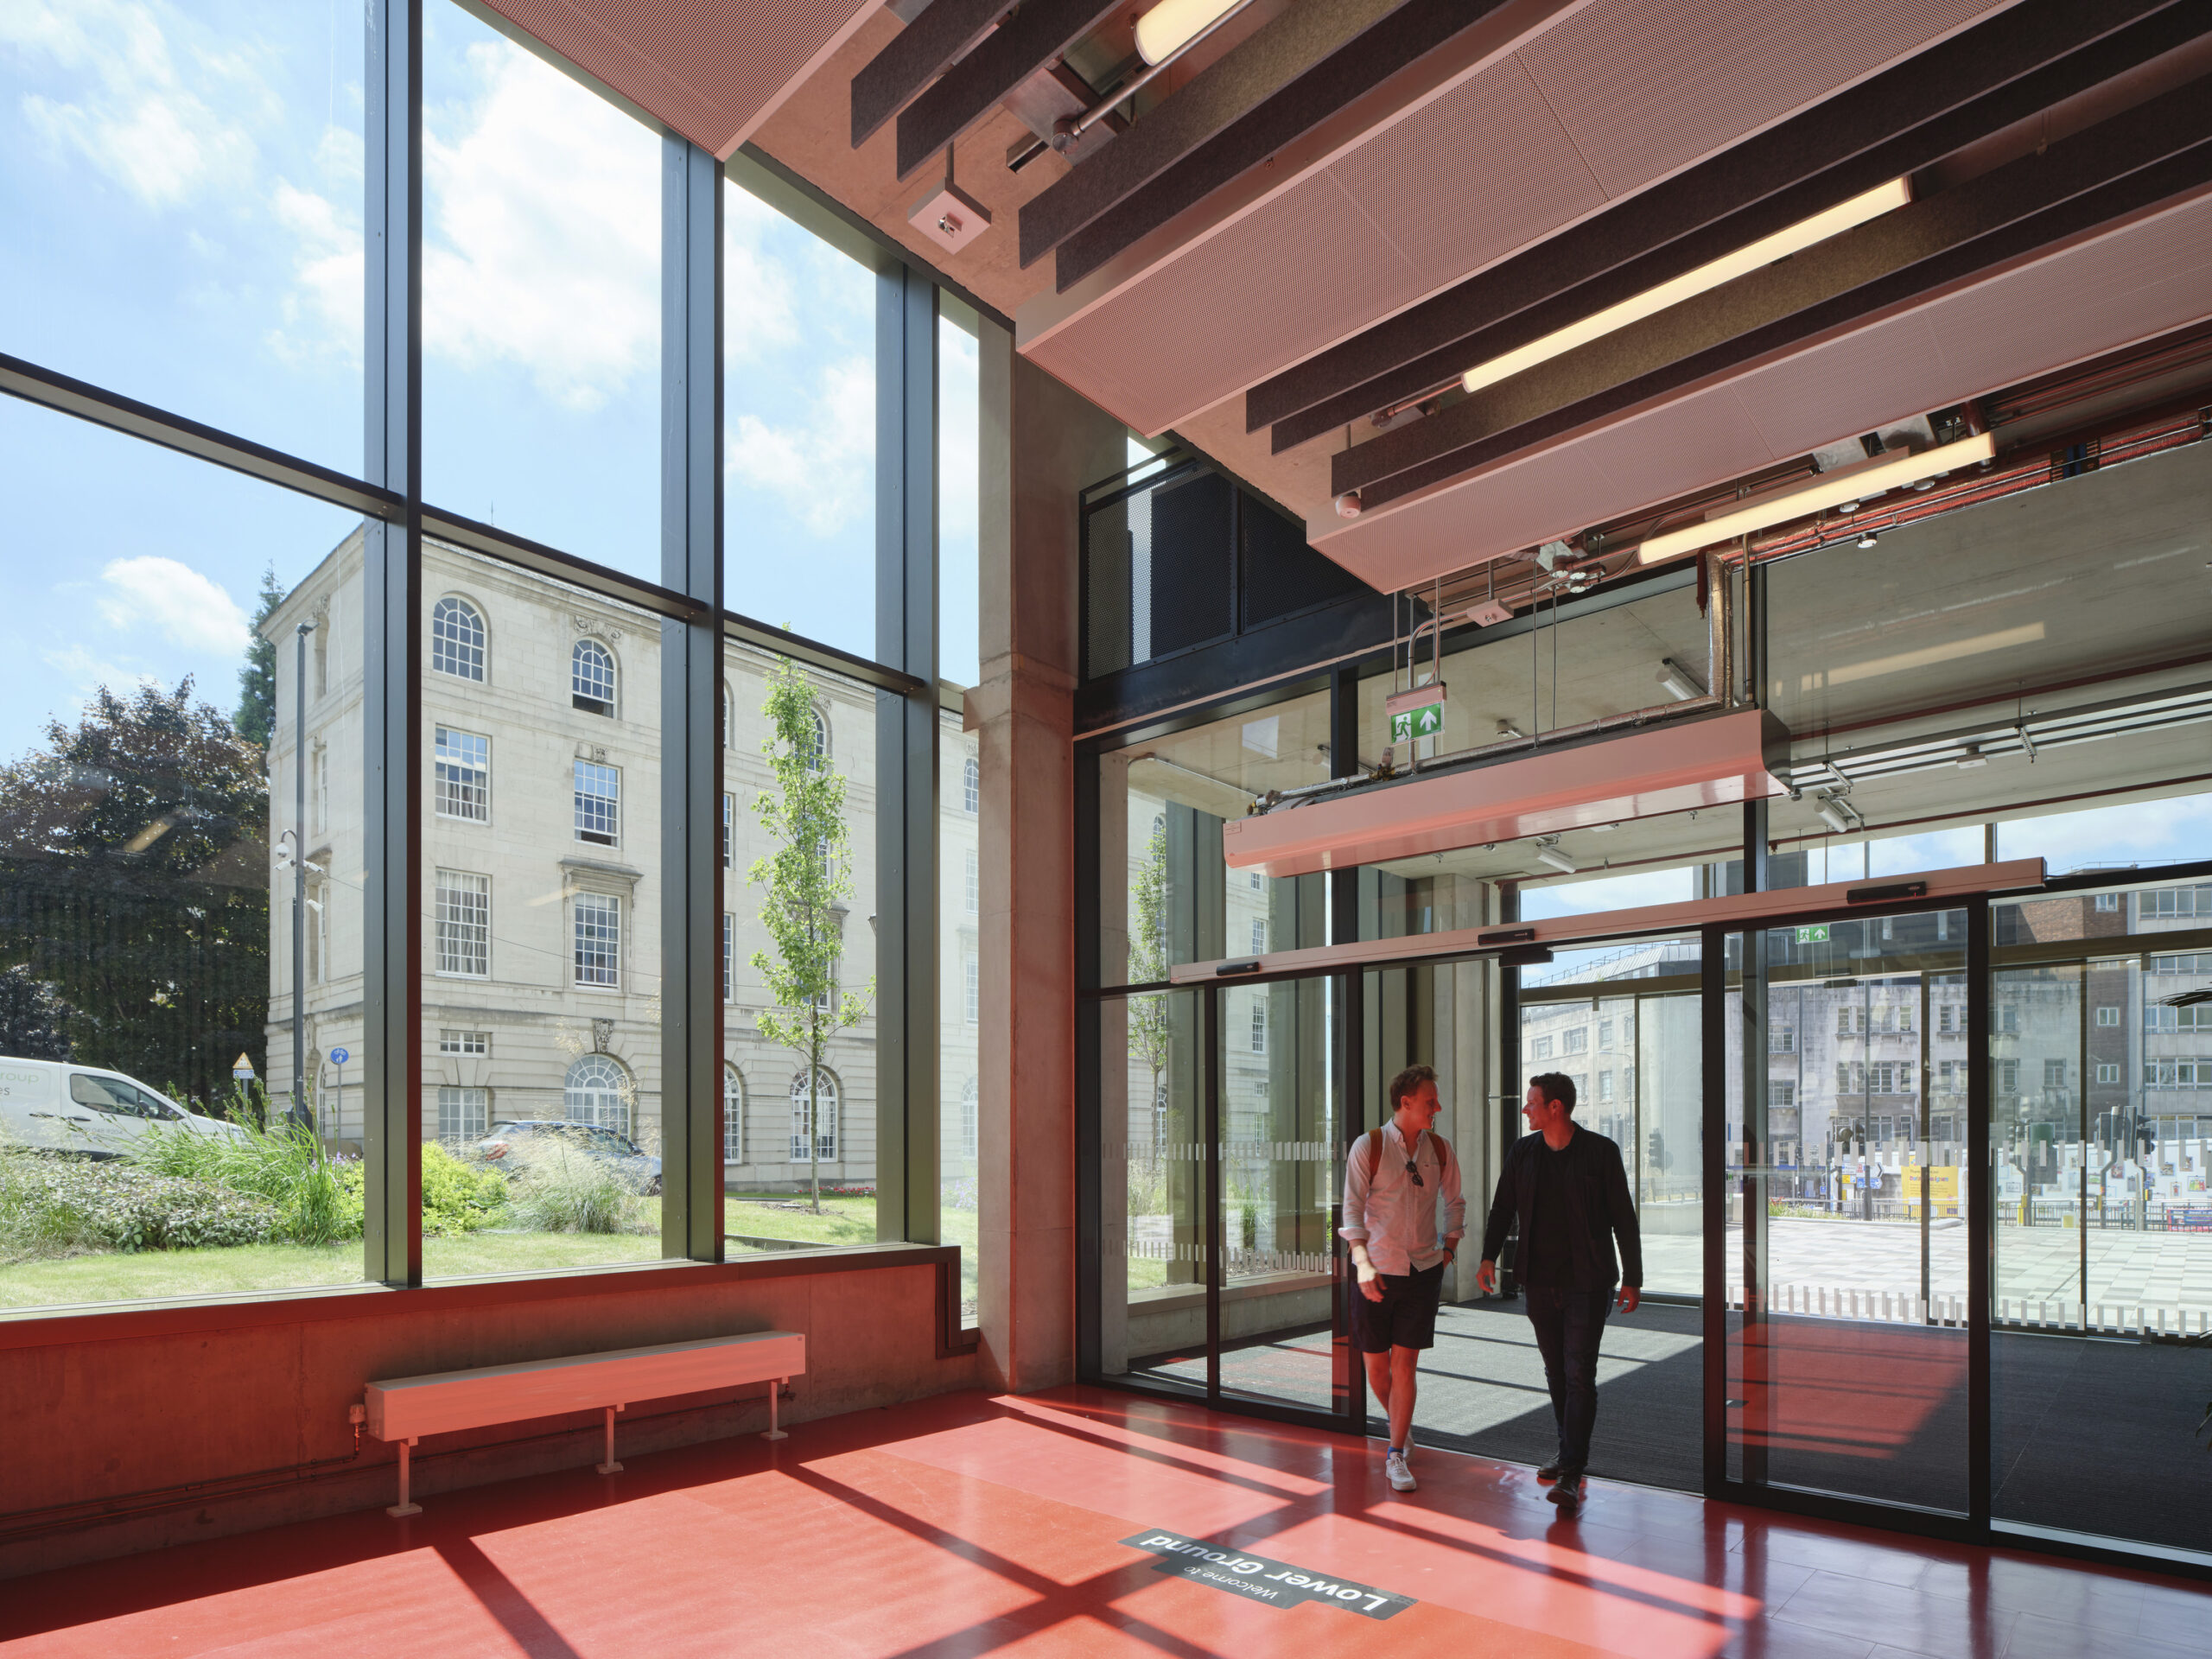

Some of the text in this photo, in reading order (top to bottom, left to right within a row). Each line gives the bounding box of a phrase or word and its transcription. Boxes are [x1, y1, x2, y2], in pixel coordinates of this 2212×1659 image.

[1140, 1535, 1389, 1611] Lower Ground
[1184, 1567, 1279, 1599] Welcome to
